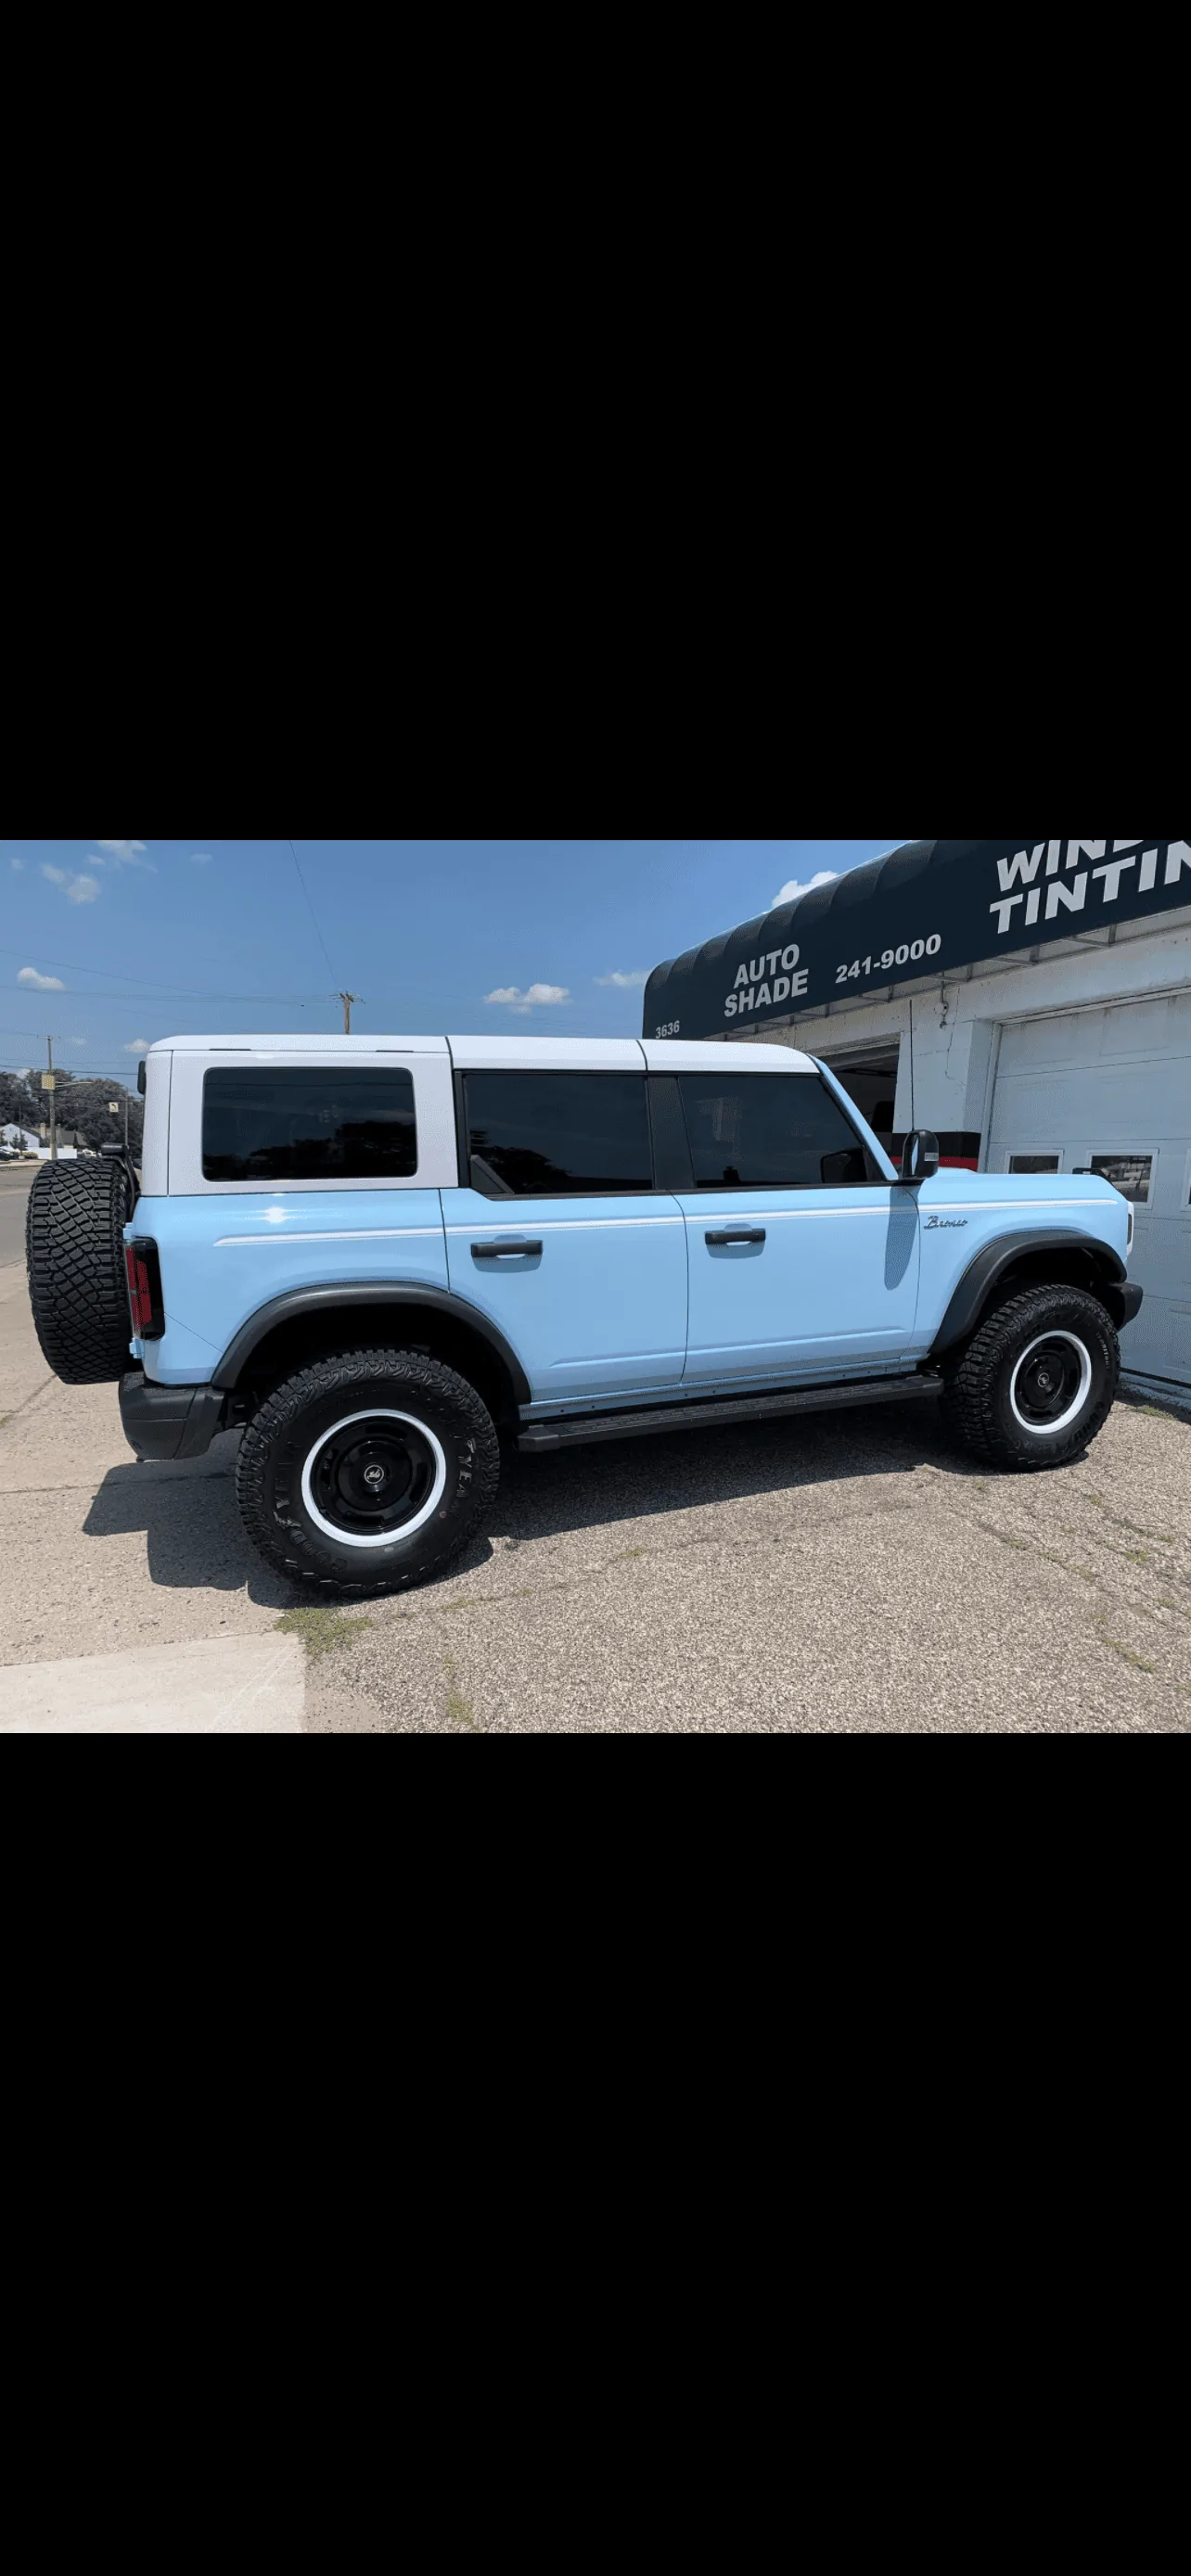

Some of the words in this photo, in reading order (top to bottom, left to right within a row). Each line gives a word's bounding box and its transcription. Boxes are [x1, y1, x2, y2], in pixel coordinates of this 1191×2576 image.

[733, 943, 800, 989] AUTO
[835, 933, 941, 984] 241-9000
[724, 968, 809, 1018] SHADE
[655, 1019, 680, 1039] 3636
[923, 1215, 967, 1230] Bronco
